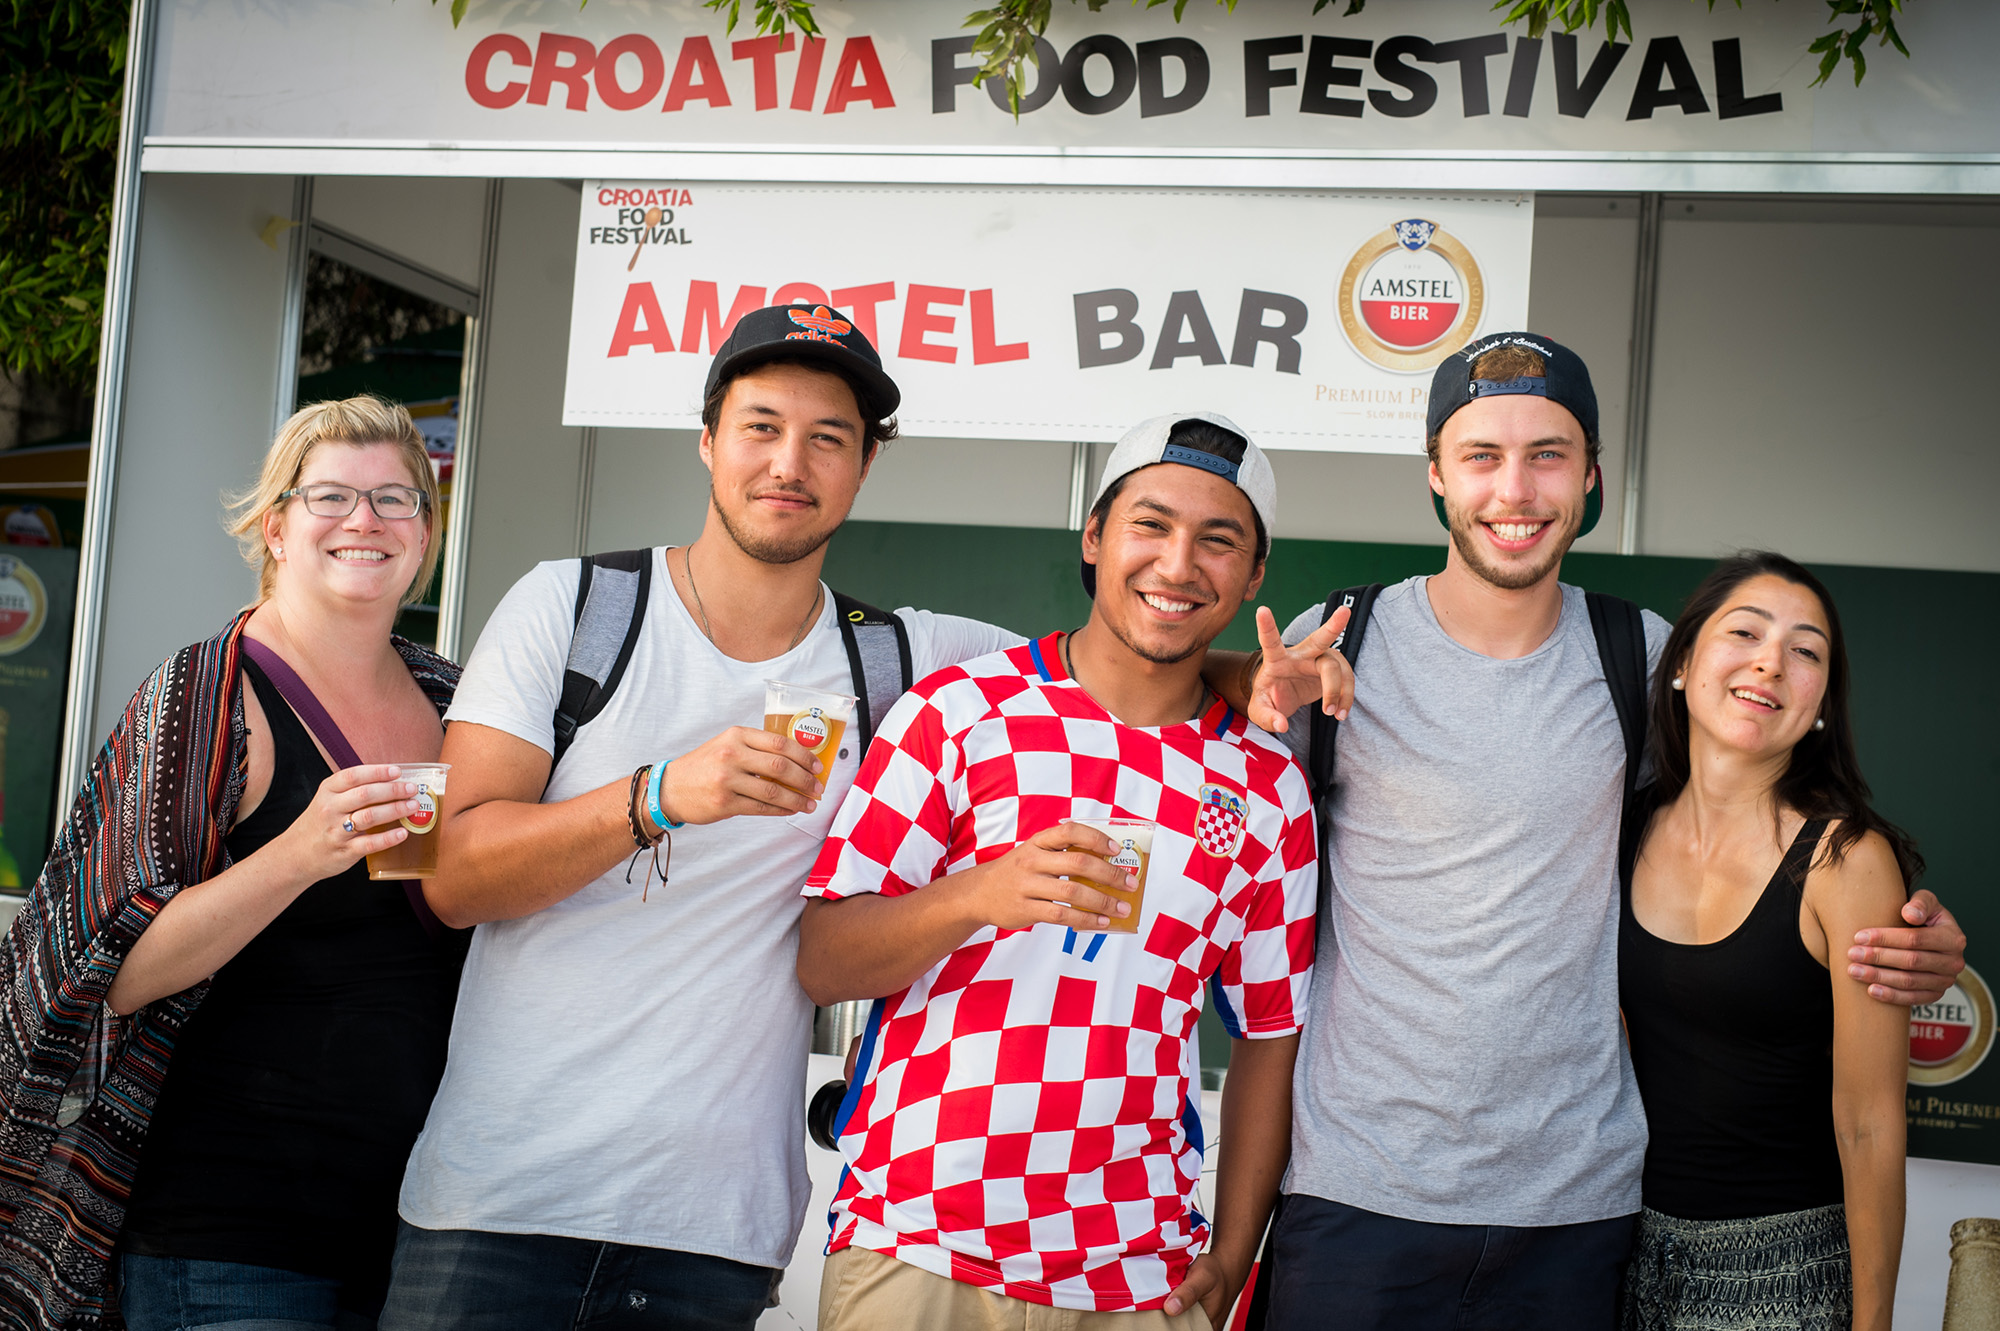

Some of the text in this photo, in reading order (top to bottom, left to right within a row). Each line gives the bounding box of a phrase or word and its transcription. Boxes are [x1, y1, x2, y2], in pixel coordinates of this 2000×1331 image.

[465, 31, 1783, 121] CROATIA FOOD FESTIVAL
[598, 188, 693, 207] CROATIA
[618, 208, 674, 226] FOD
[590, 227, 693, 245] FESTIVAL
[1370, 279, 1453, 298] AMSTEL
[1389, 305, 1429, 320] BIER
[784, 330, 849, 350] adid
[1073, 288, 1309, 375] BAR
[1315, 384, 1402, 404] PREMIUM
[1366, 410, 1427, 421] SLOW BREW
[798, 723, 824, 735] AMSTEL
[802, 733, 816, 741] BIER
[420, 803, 432, 811] STEL
[1113, 857, 1138, 866] AMSTEL
[1911, 1003, 1967, 1023] MSTEL
[1910, 1024, 1945, 1040] BIER
